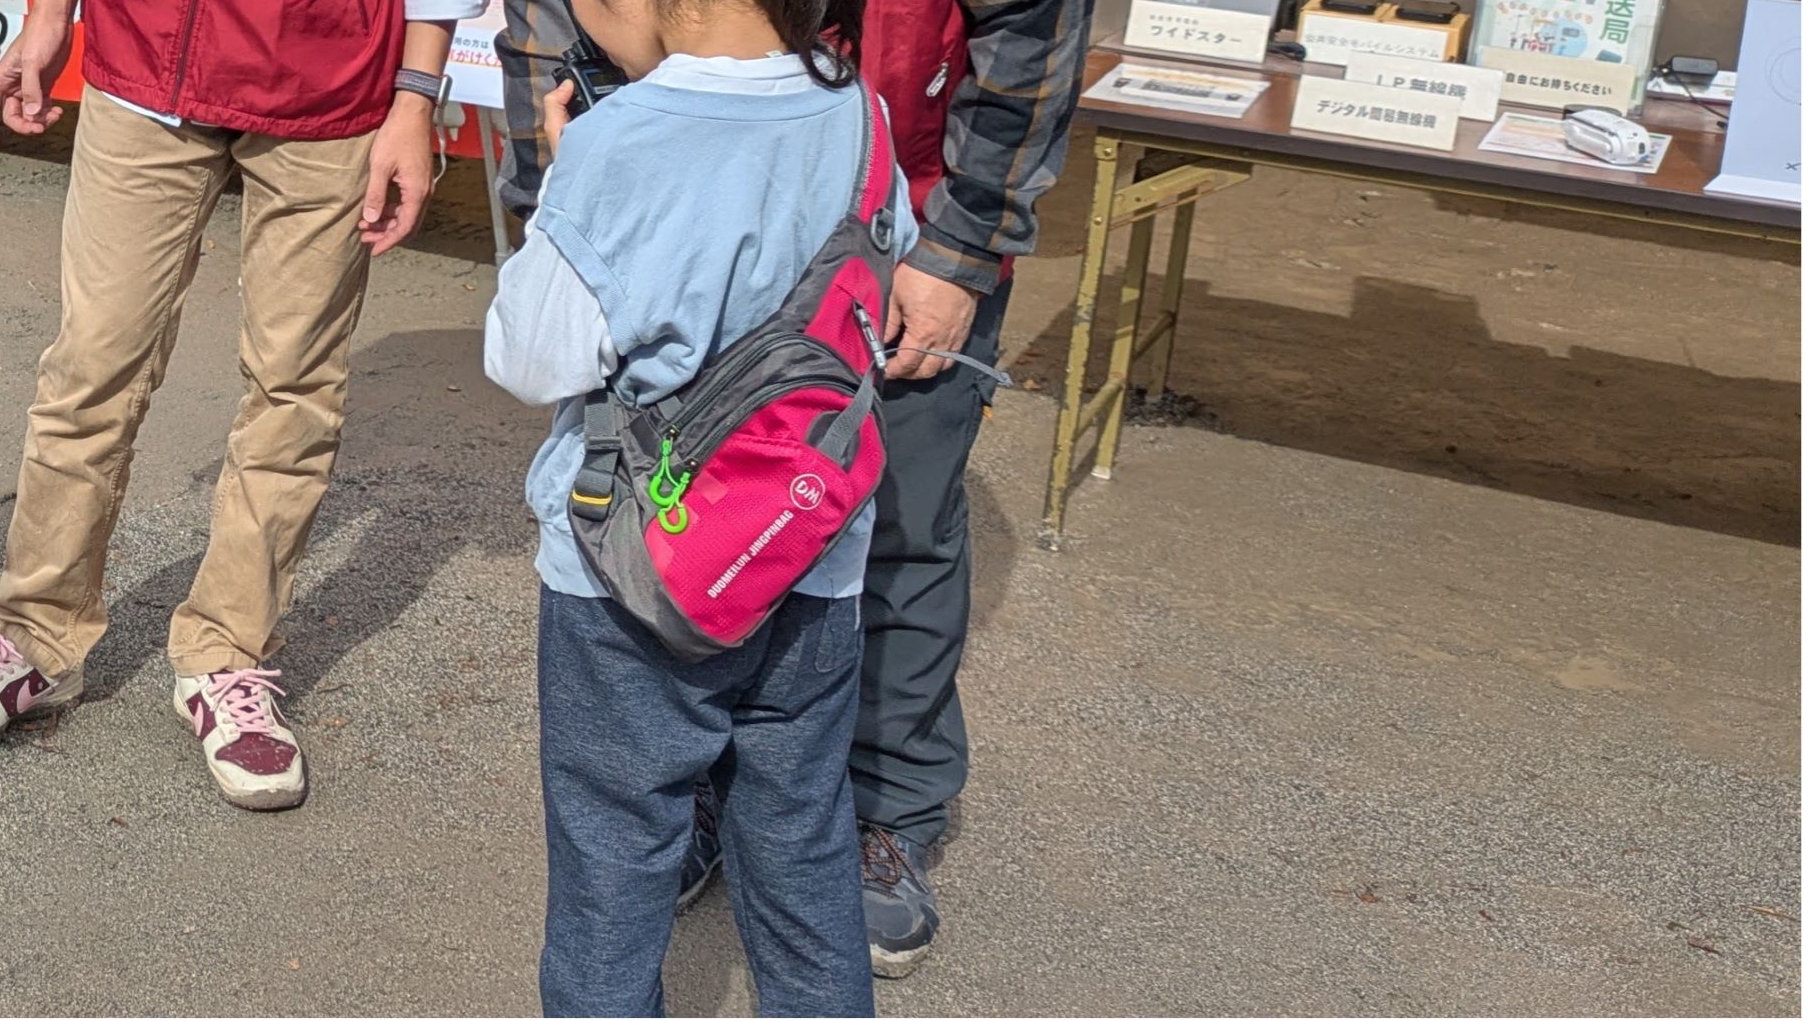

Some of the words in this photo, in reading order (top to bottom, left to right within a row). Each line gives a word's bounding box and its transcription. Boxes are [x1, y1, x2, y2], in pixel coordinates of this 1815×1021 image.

[1150, 25, 1243, 44] ワイドスター
[1305, 33, 1439, 58] 公共安全モバイルシステム
[1505, 71, 1613, 96] 自由にお持ちください
[1316, 99, 1437, 130] デジタル簡易無線機
[795, 480, 820, 505] DM
[748, 509, 795, 557] JINGPINBAG
